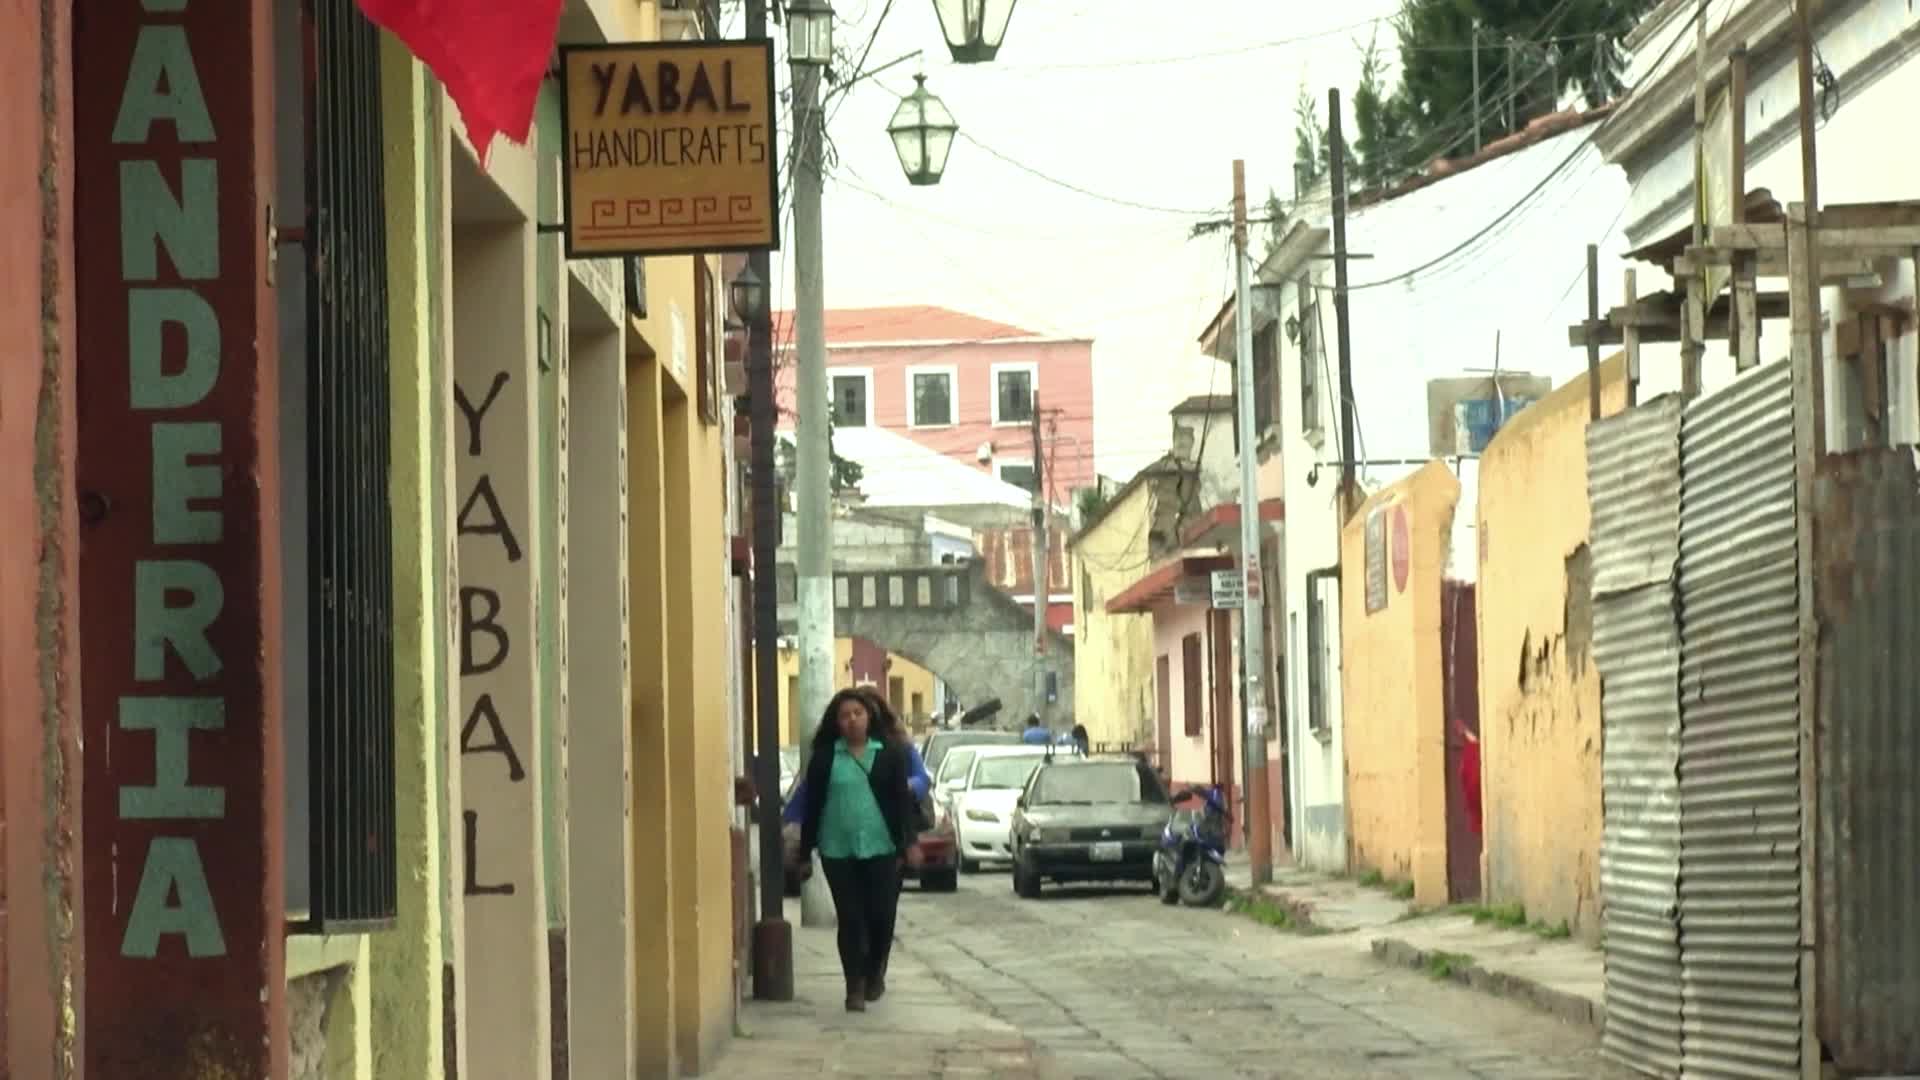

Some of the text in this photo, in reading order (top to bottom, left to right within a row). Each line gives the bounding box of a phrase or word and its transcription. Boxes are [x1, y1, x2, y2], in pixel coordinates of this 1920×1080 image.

[573, 123, 766, 169] HANDICRAFTS
[591, 58, 752, 117] YABAL
[112, 0, 228, 958] ANDERIA
[454, 370, 525, 896] YABAL
